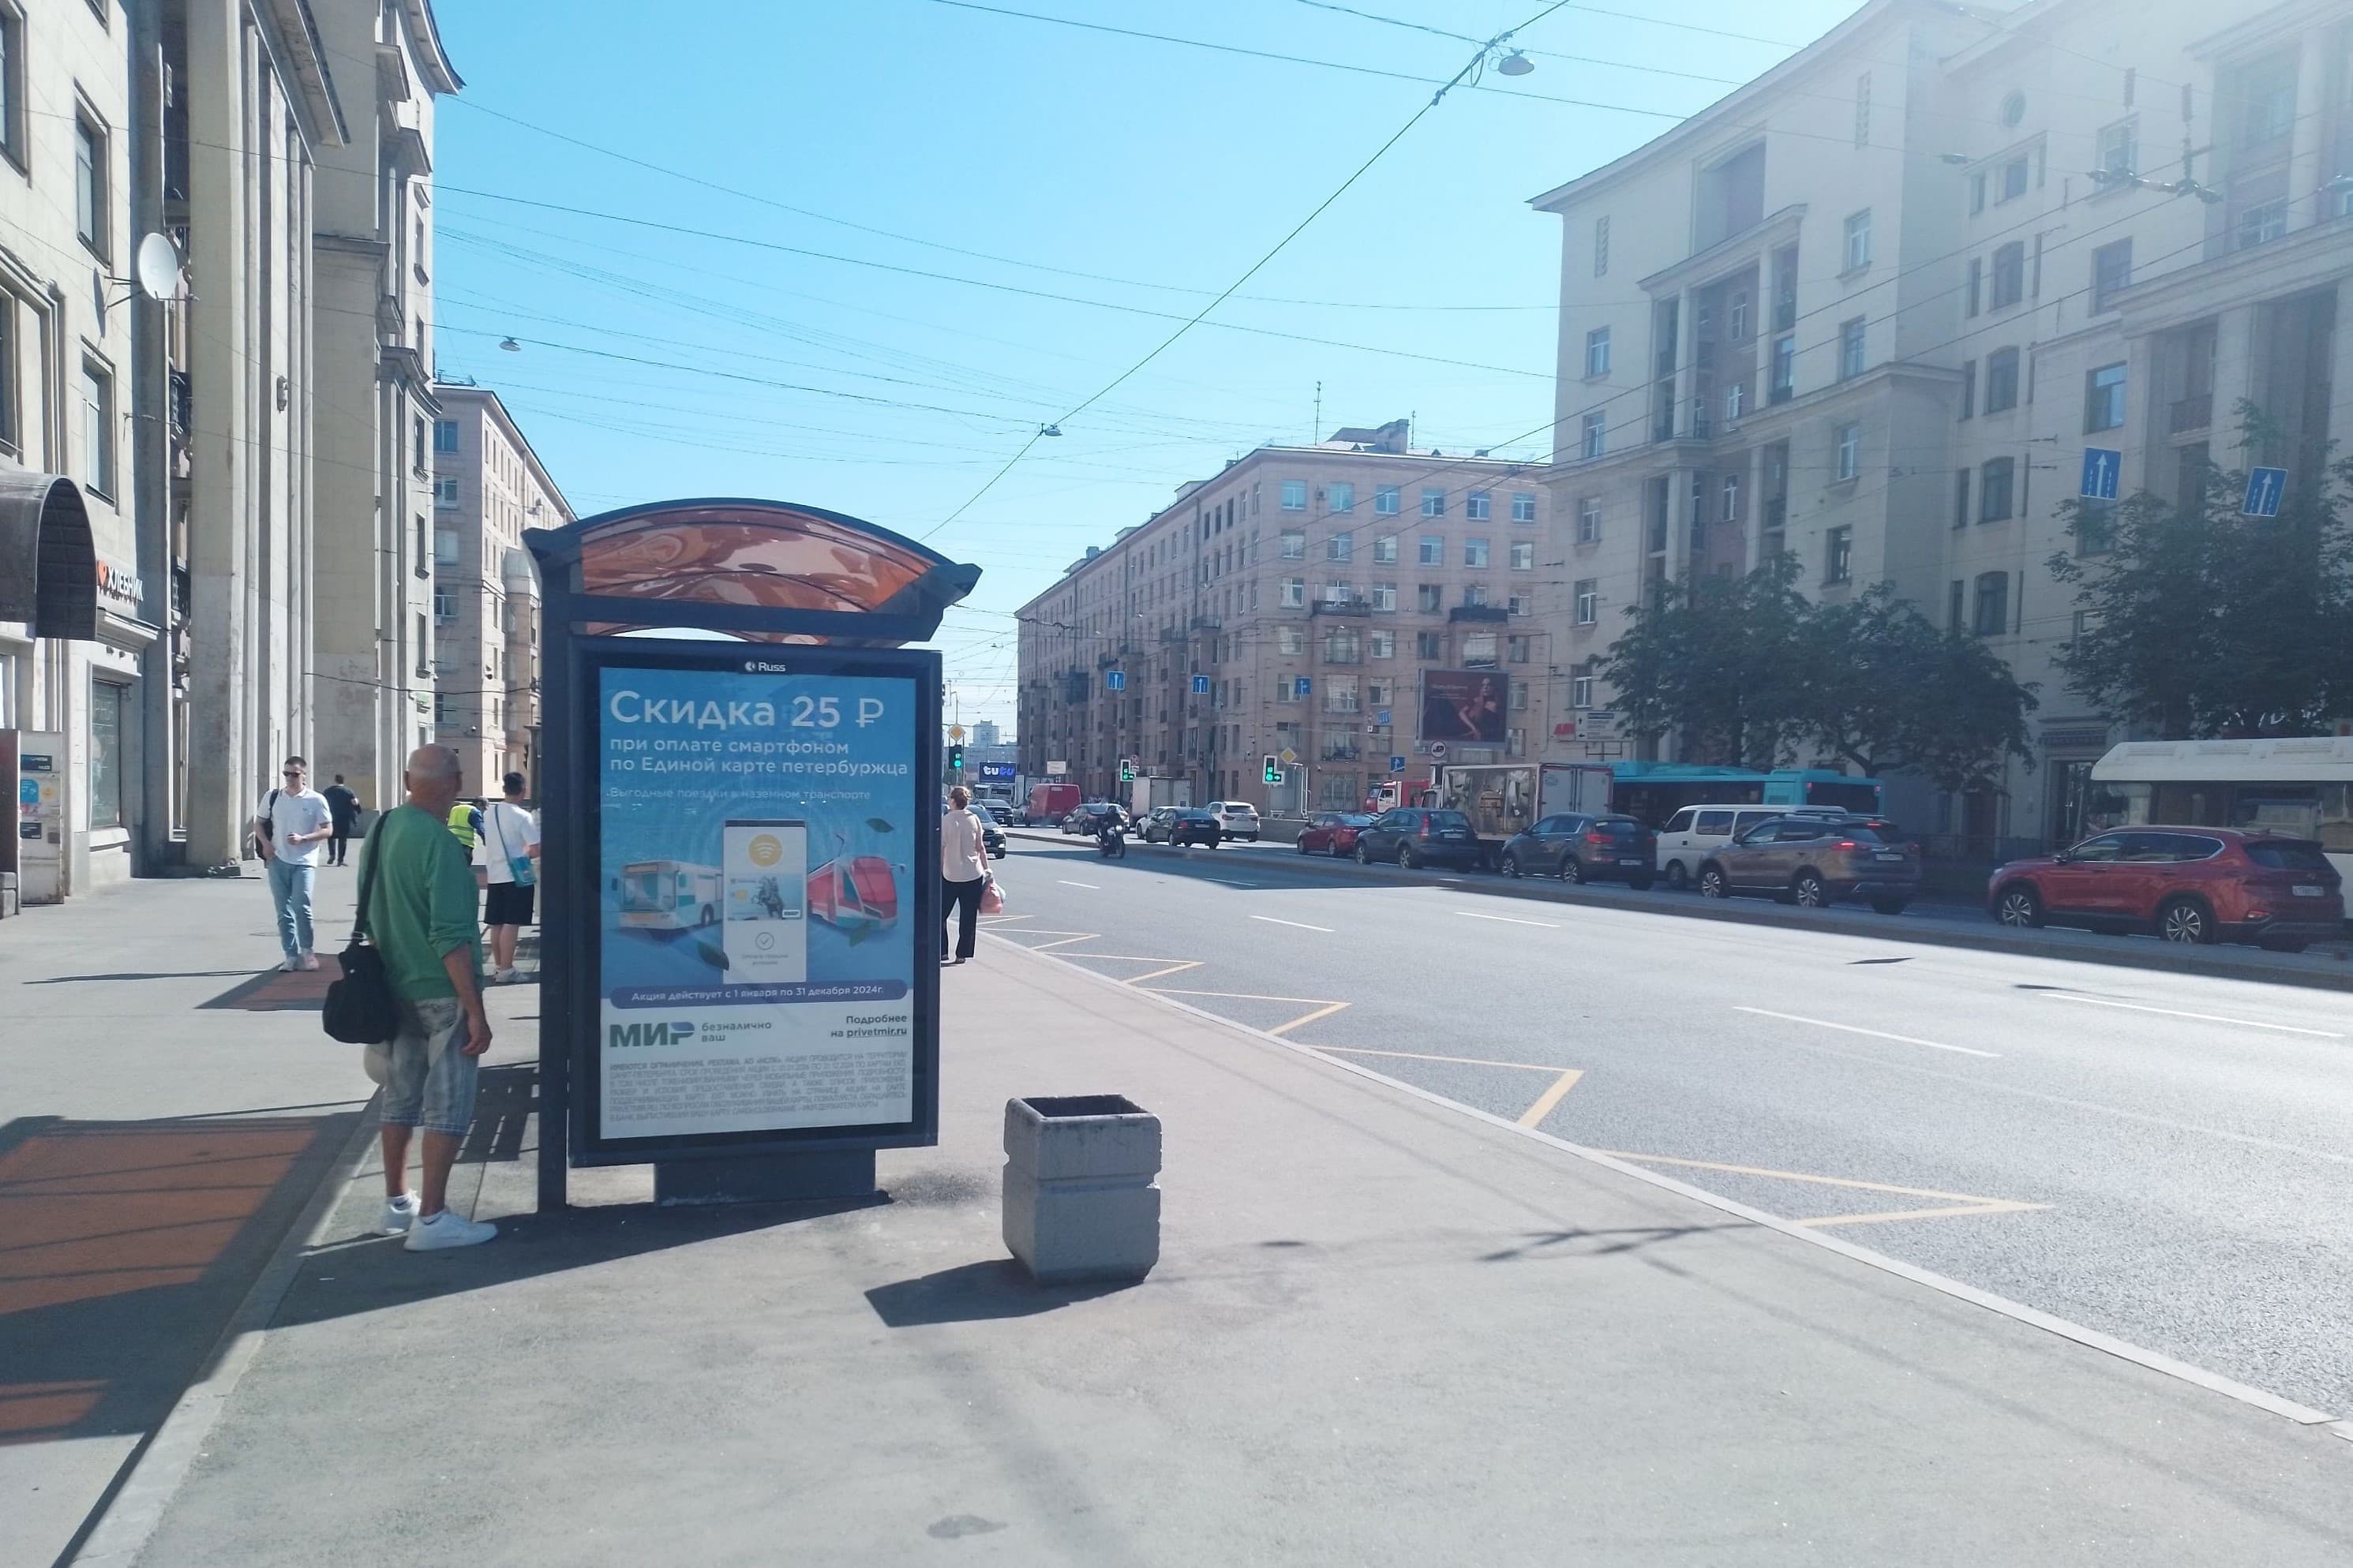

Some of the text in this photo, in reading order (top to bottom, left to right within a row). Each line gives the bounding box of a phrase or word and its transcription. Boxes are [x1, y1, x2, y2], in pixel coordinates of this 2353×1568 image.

[107, 565, 144, 601] ХЛЕБНИК
[758, 661, 786, 672] Russ
[610, 690, 775, 731] Скидка
[792, 696, 840, 728] 25
[610, 739, 849, 756] при оплате смартфоном
[610, 757, 909, 777] по Единой карте петербуржца
[983, 765, 1014, 776] tutu
[804, 791, 871, 801] транспорте
[631, 992, 666, 1002] Акция
[668, 991, 723, 1001] действует
[725, 990, 731, 998] с
[740, 989, 777, 1000] января
[796, 987, 806, 996] 31
[808, 986, 851, 997] декабря
[853, 986, 884, 994] 2024г.
[845, 1014, 908, 1024] Подробнее
[701, 1022, 772, 1032] безналично
[847, 1027, 908, 1038] privetmir.ru
[609, 1021, 695, 1048] МИР
[701, 1034, 726, 1042] ваш
